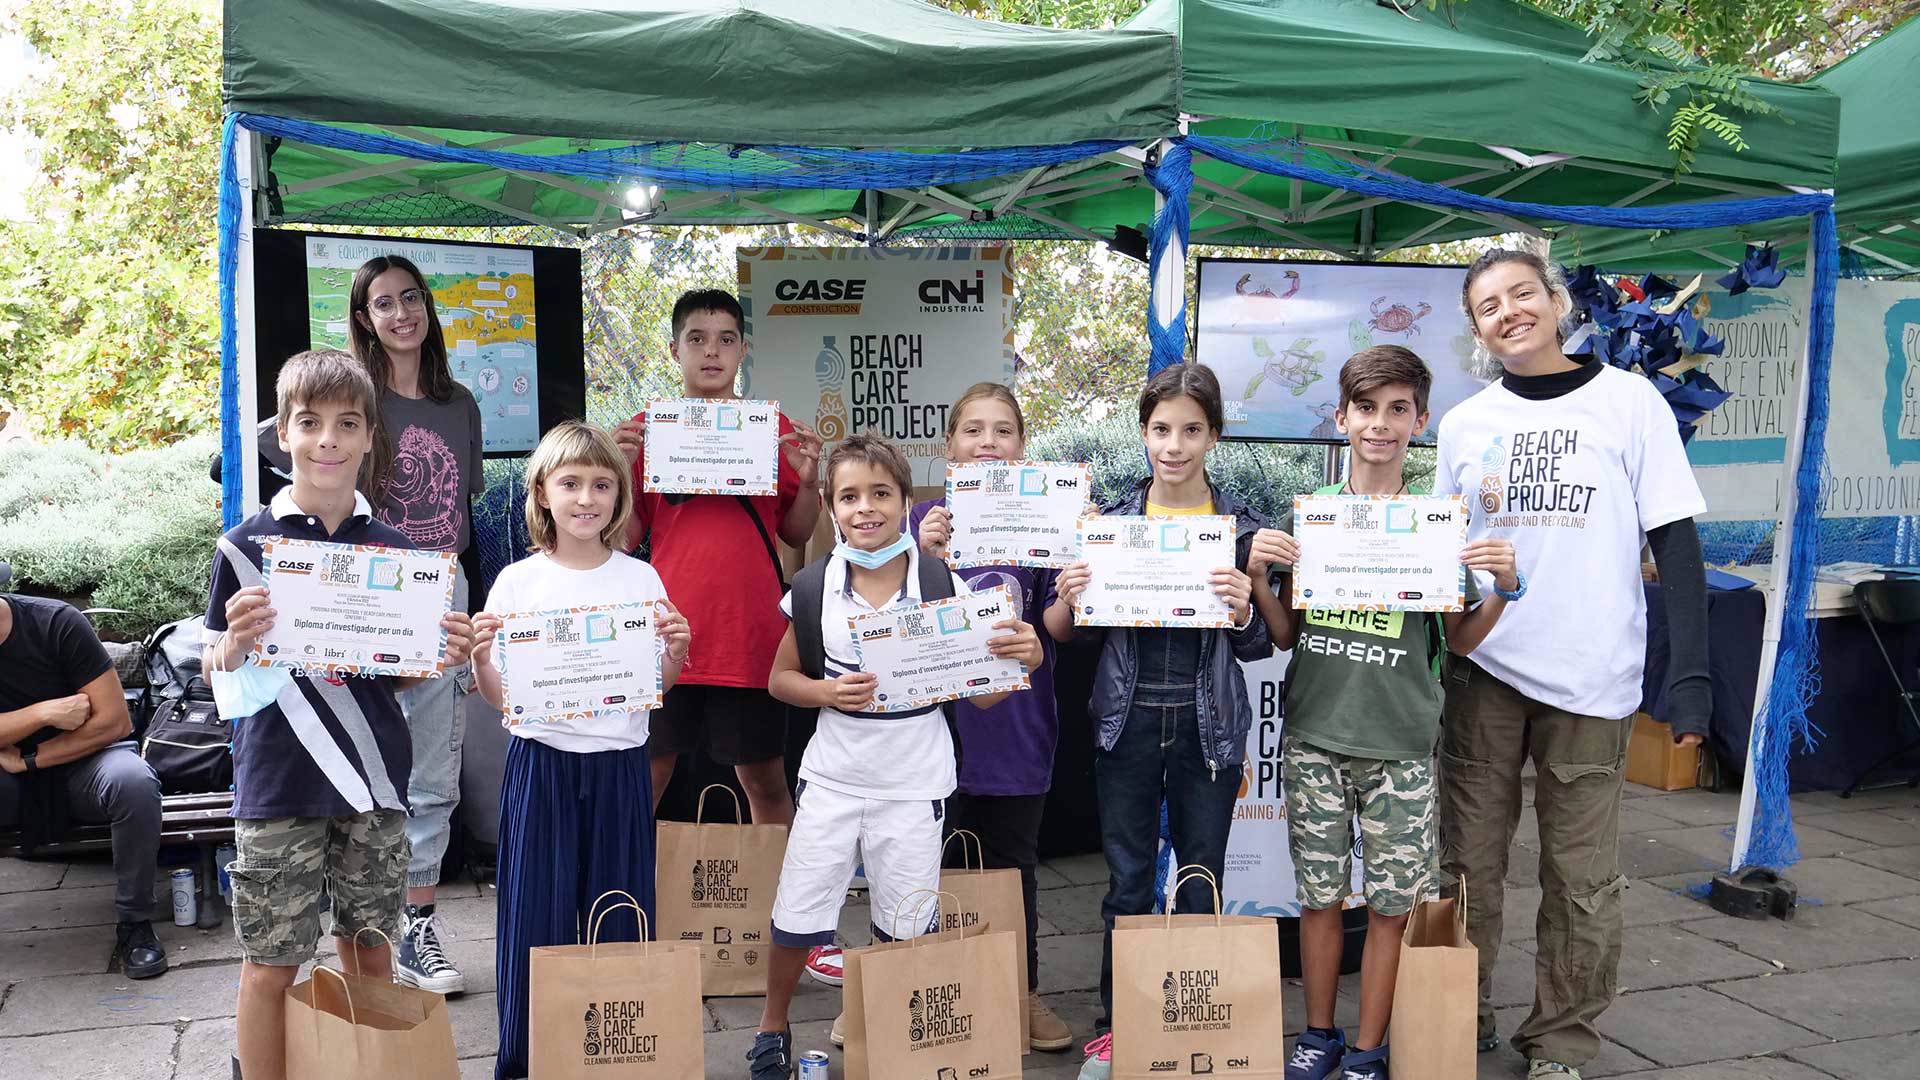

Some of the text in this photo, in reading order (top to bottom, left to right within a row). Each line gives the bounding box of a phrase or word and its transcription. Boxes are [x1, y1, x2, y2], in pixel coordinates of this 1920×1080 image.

[339, 245, 368, 260] EQUIPO
[775, 279, 866, 300] CASE
[784, 304, 858, 313] CONSTRUCTION
[850, 334, 922, 369] BEACH
[851, 371, 909, 405] CARE
[852, 405, 949, 439] PROJECT
[1700, 400, 1783, 435] ESTIVAL
[1512, 429, 1578, 457] BEACH
[897, 444, 946, 457] ECYCLING
[670, 456, 689, 464] Diploma
[1509, 457, 1562, 483] CARE
[1507, 484, 1596, 514] PROJECT
[1352, 504, 1372, 512] BEACH
[1352, 512, 1368, 521] CARE
[1521, 516, 1537, 527] AND
[970, 526, 989, 535] Diploma
[1352, 521, 1378, 530] PROJECT
[1130, 540, 1154, 548] PROJECT
[278, 561, 314, 571] CASE
[332, 553, 355, 565] BEACH
[331, 564, 349, 573] CARE
[1325, 565, 1350, 574] Diploma
[1400, 567, 1410, 575] per
[330, 573, 360, 584] PROJECT
[1105, 583, 1128, 591] Diploma
[294, 618, 323, 630] Diploma
[325, 621, 377, 635] d'investigador
[378, 625, 391, 636] per
[392, 627, 401, 635] un
[863, 627, 892, 638] CASE
[908, 626, 934, 636] PROJECT
[510, 630, 540, 639] CASE
[555, 633, 580, 643] PROJECT
[1300, 632, 1407, 667] REPEAT
[892, 668, 917, 678] Diploma
[963, 660, 973, 668] per
[533, 678, 557, 688] Diploma
[604, 673, 613, 682] per
[615, 672, 623, 680] un
[707, 860, 738, 873] BEACH
[707, 874, 731, 887] CARE
[707, 888, 749, 901] PROJECT
[946, 912, 978, 929] BEACH
[1180, 970, 1218, 988] BEACH
[926, 983, 961, 1005] BEACH
[1181, 988, 1211, 1005] CARE
[604, 1001, 644, 1019] BEACH
[926, 1001, 954, 1022] CARE
[1182, 1004, 1232, 1022] PROJECT
[604, 1019, 636, 1037] CARE
[926, 1014, 973, 1039] PROJECT
[1163, 1024, 1189, 1032] CLEANING
[1203, 1022, 1231, 1030] RECYCLING
[604, 1035, 658, 1054] PROJECT
[911, 1032, 972, 1052] CLEANING AND RECYCLING
[584, 1057, 611, 1065] CLEANING
[626, 1055, 656, 1063] RECYCLING
